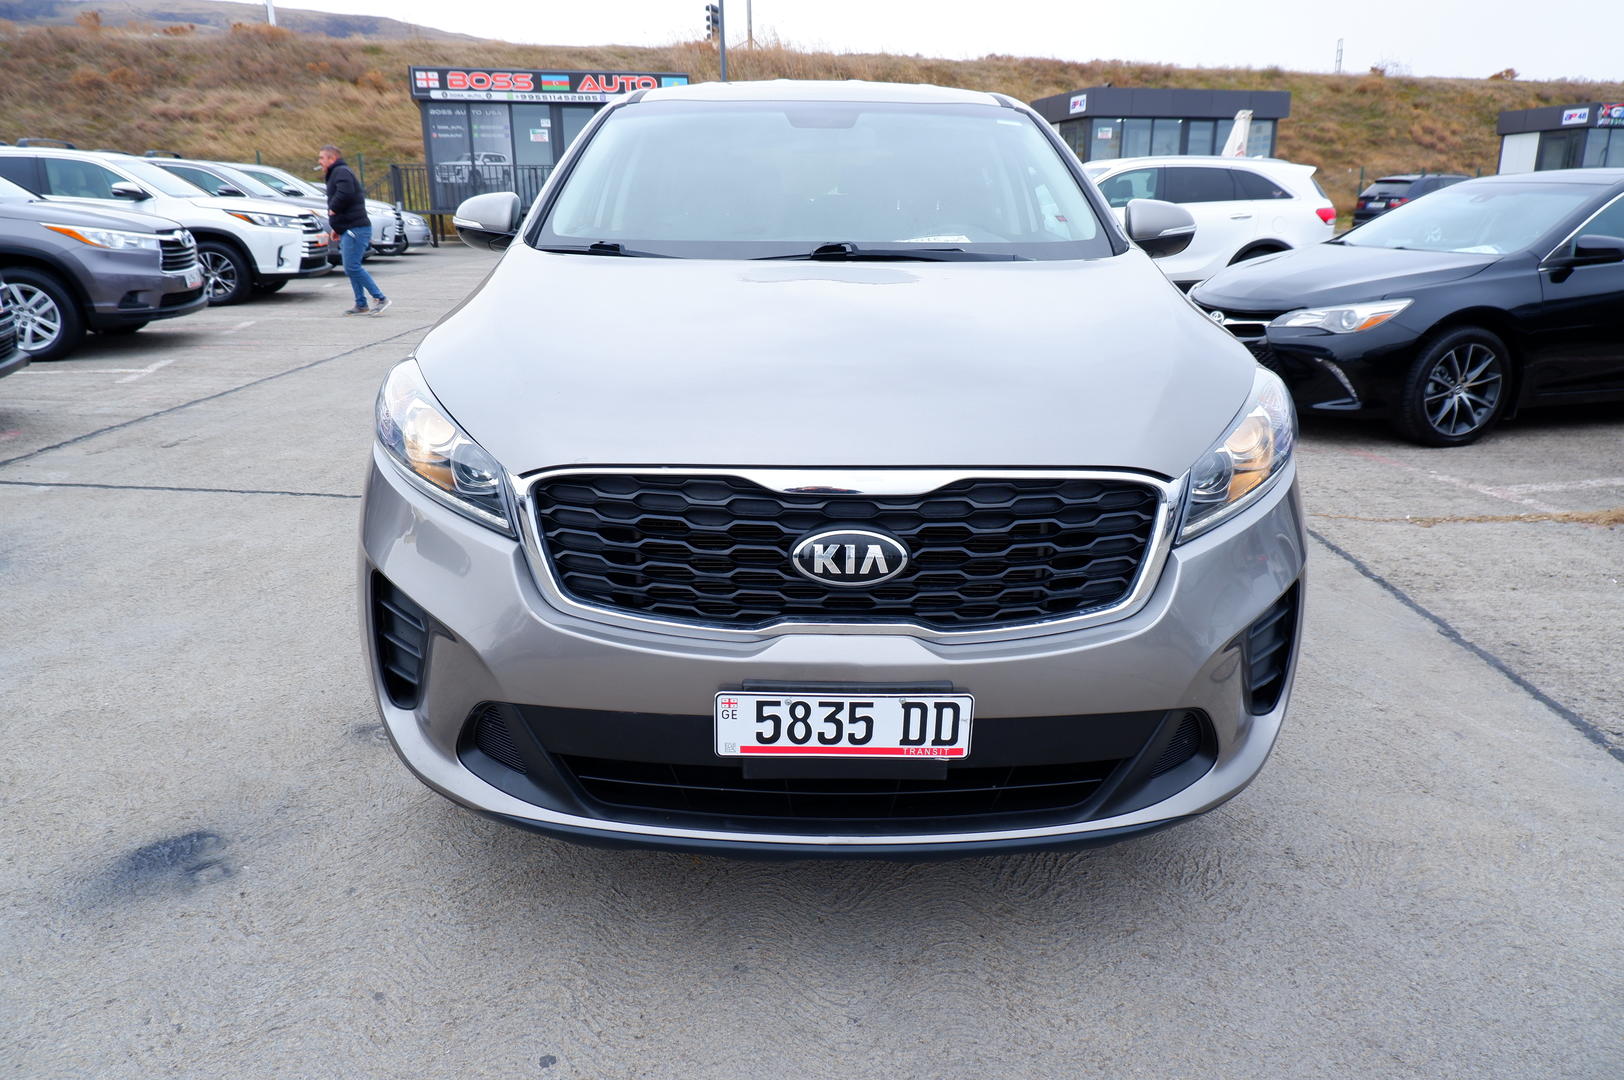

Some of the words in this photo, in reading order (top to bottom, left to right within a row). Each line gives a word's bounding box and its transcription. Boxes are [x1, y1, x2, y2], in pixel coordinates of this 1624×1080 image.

[447, 71, 534, 91] BOSS
[577, 74, 658, 93] AUTO
[813, 544, 889, 574] KIA
[721, 709, 738, 720] GE
[755, 700, 875, 746] 5835
[899, 701, 961, 746] DD
[903, 747, 950, 756] TRANSIT
